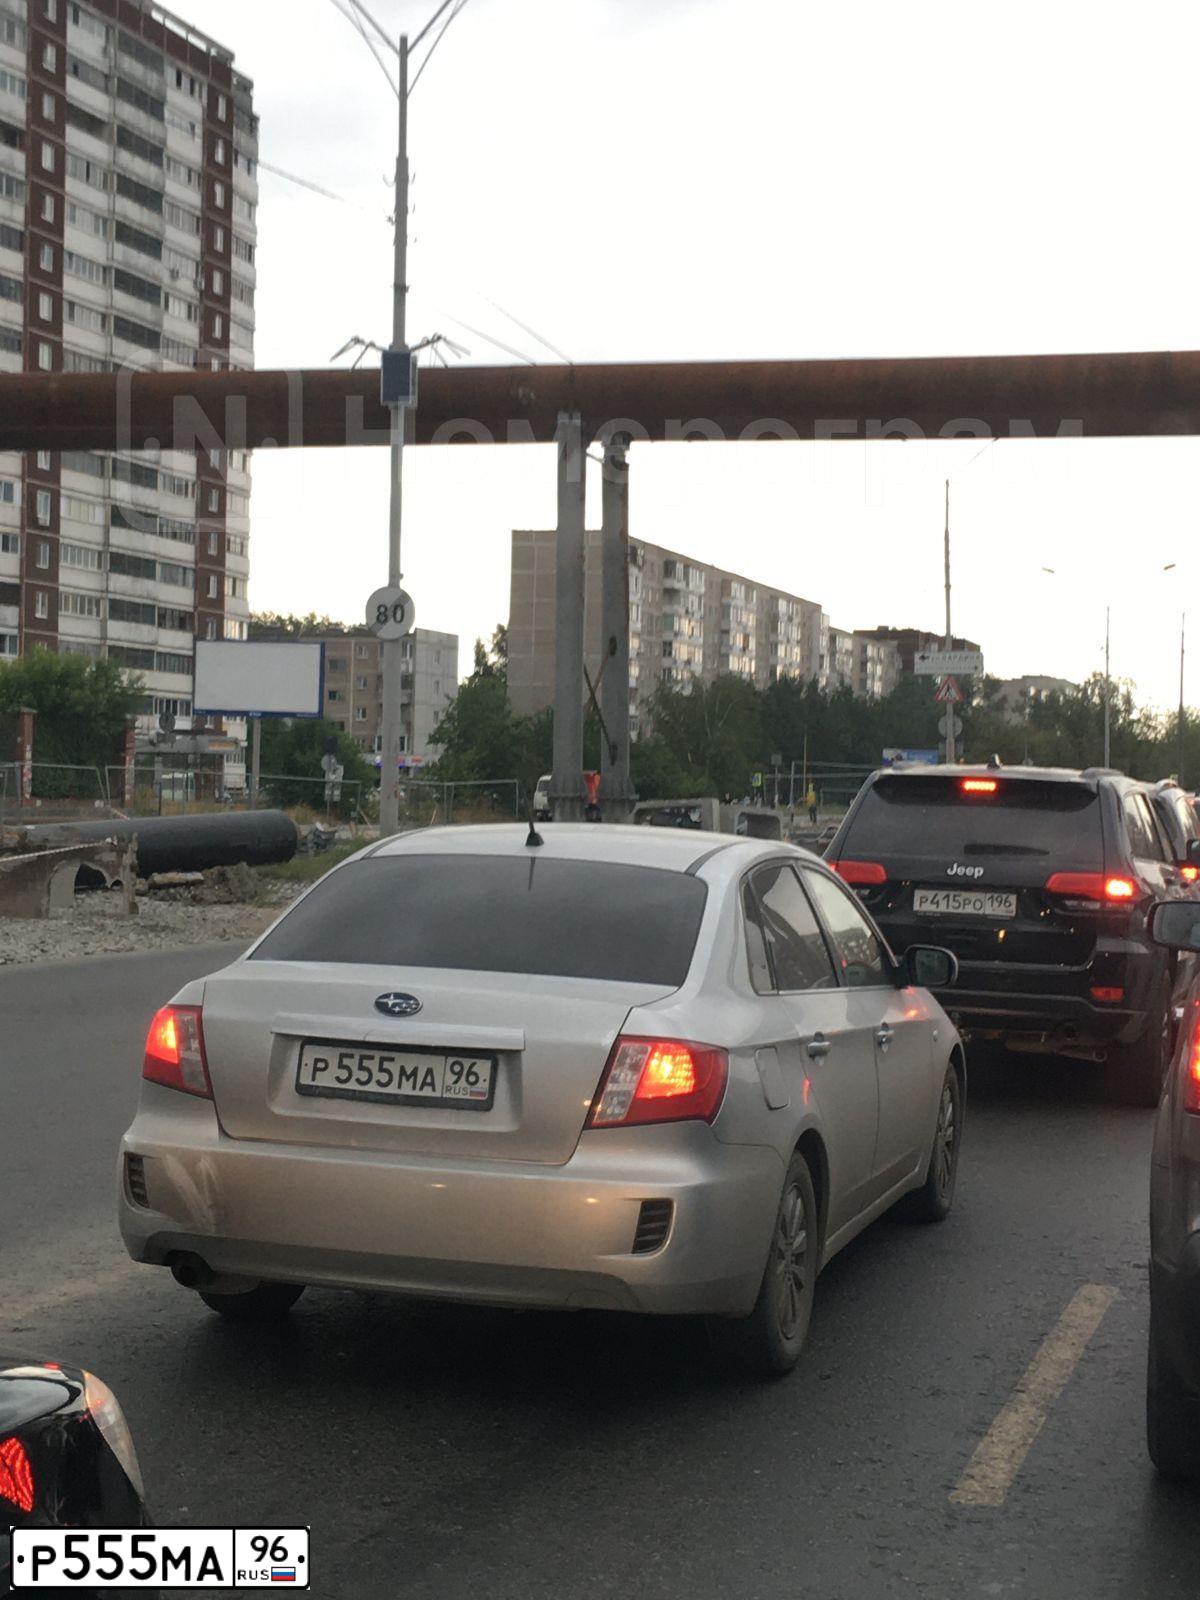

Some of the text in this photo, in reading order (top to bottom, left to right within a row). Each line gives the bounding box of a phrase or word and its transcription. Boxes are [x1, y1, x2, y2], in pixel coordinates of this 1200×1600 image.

[377, 604, 405, 625] 80
[946, 862, 984, 879] Jeep
[919, 892, 1012, 911] Р415РО 196
[311, 1052, 480, 1092] Р555МА 96
[445, 1086, 468, 1097] RUS
